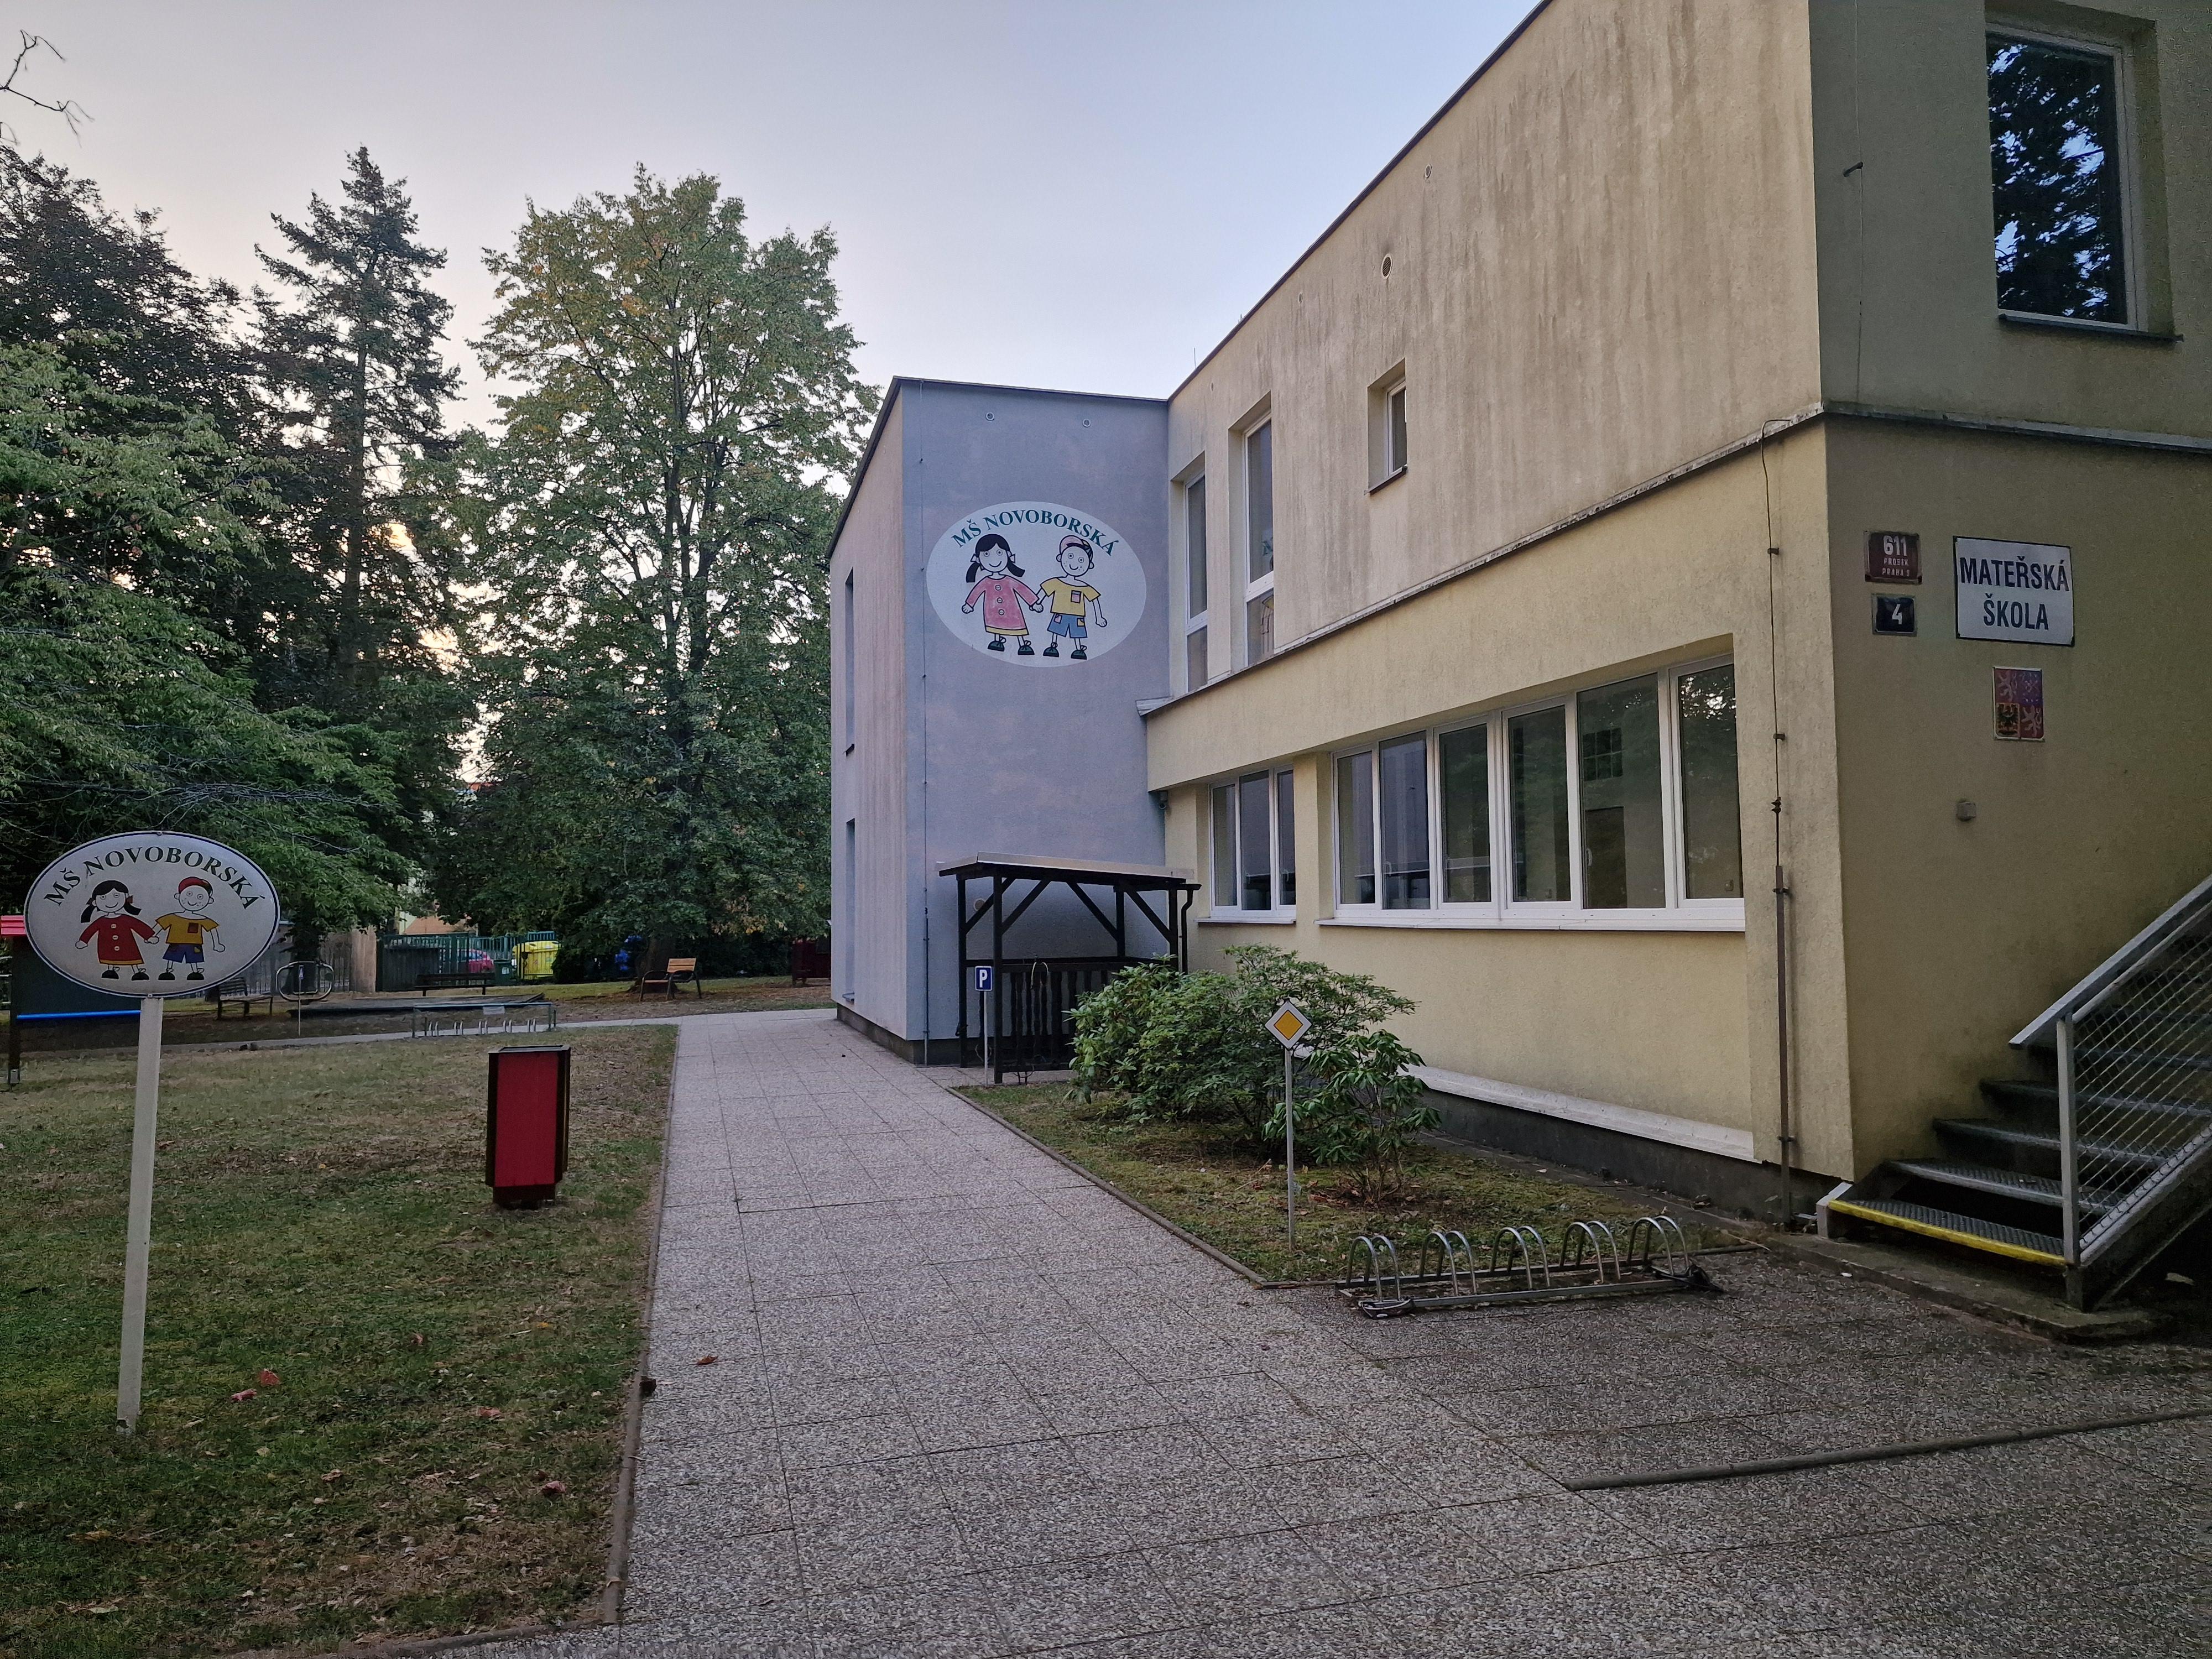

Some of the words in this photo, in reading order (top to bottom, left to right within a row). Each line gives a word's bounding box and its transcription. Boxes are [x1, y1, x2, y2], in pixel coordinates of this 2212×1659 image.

[951, 519, 982, 547] MŠ
[983, 509, 1119, 556] NOVOBORSKÁ
[1883, 535, 1907, 557] 611
[1882, 567, 1904, 576] PRAHA
[1959, 555, 2070, 591] MATEŘSKÁ
[1892, 603, 1903, 625] 4
[1983, 592, 2049, 630] ŠKOLA
[44, 867, 81, 907] MŠ
[82, 846, 265, 910] NOVOBORSKÁ
[979, 969, 988, 988] P
